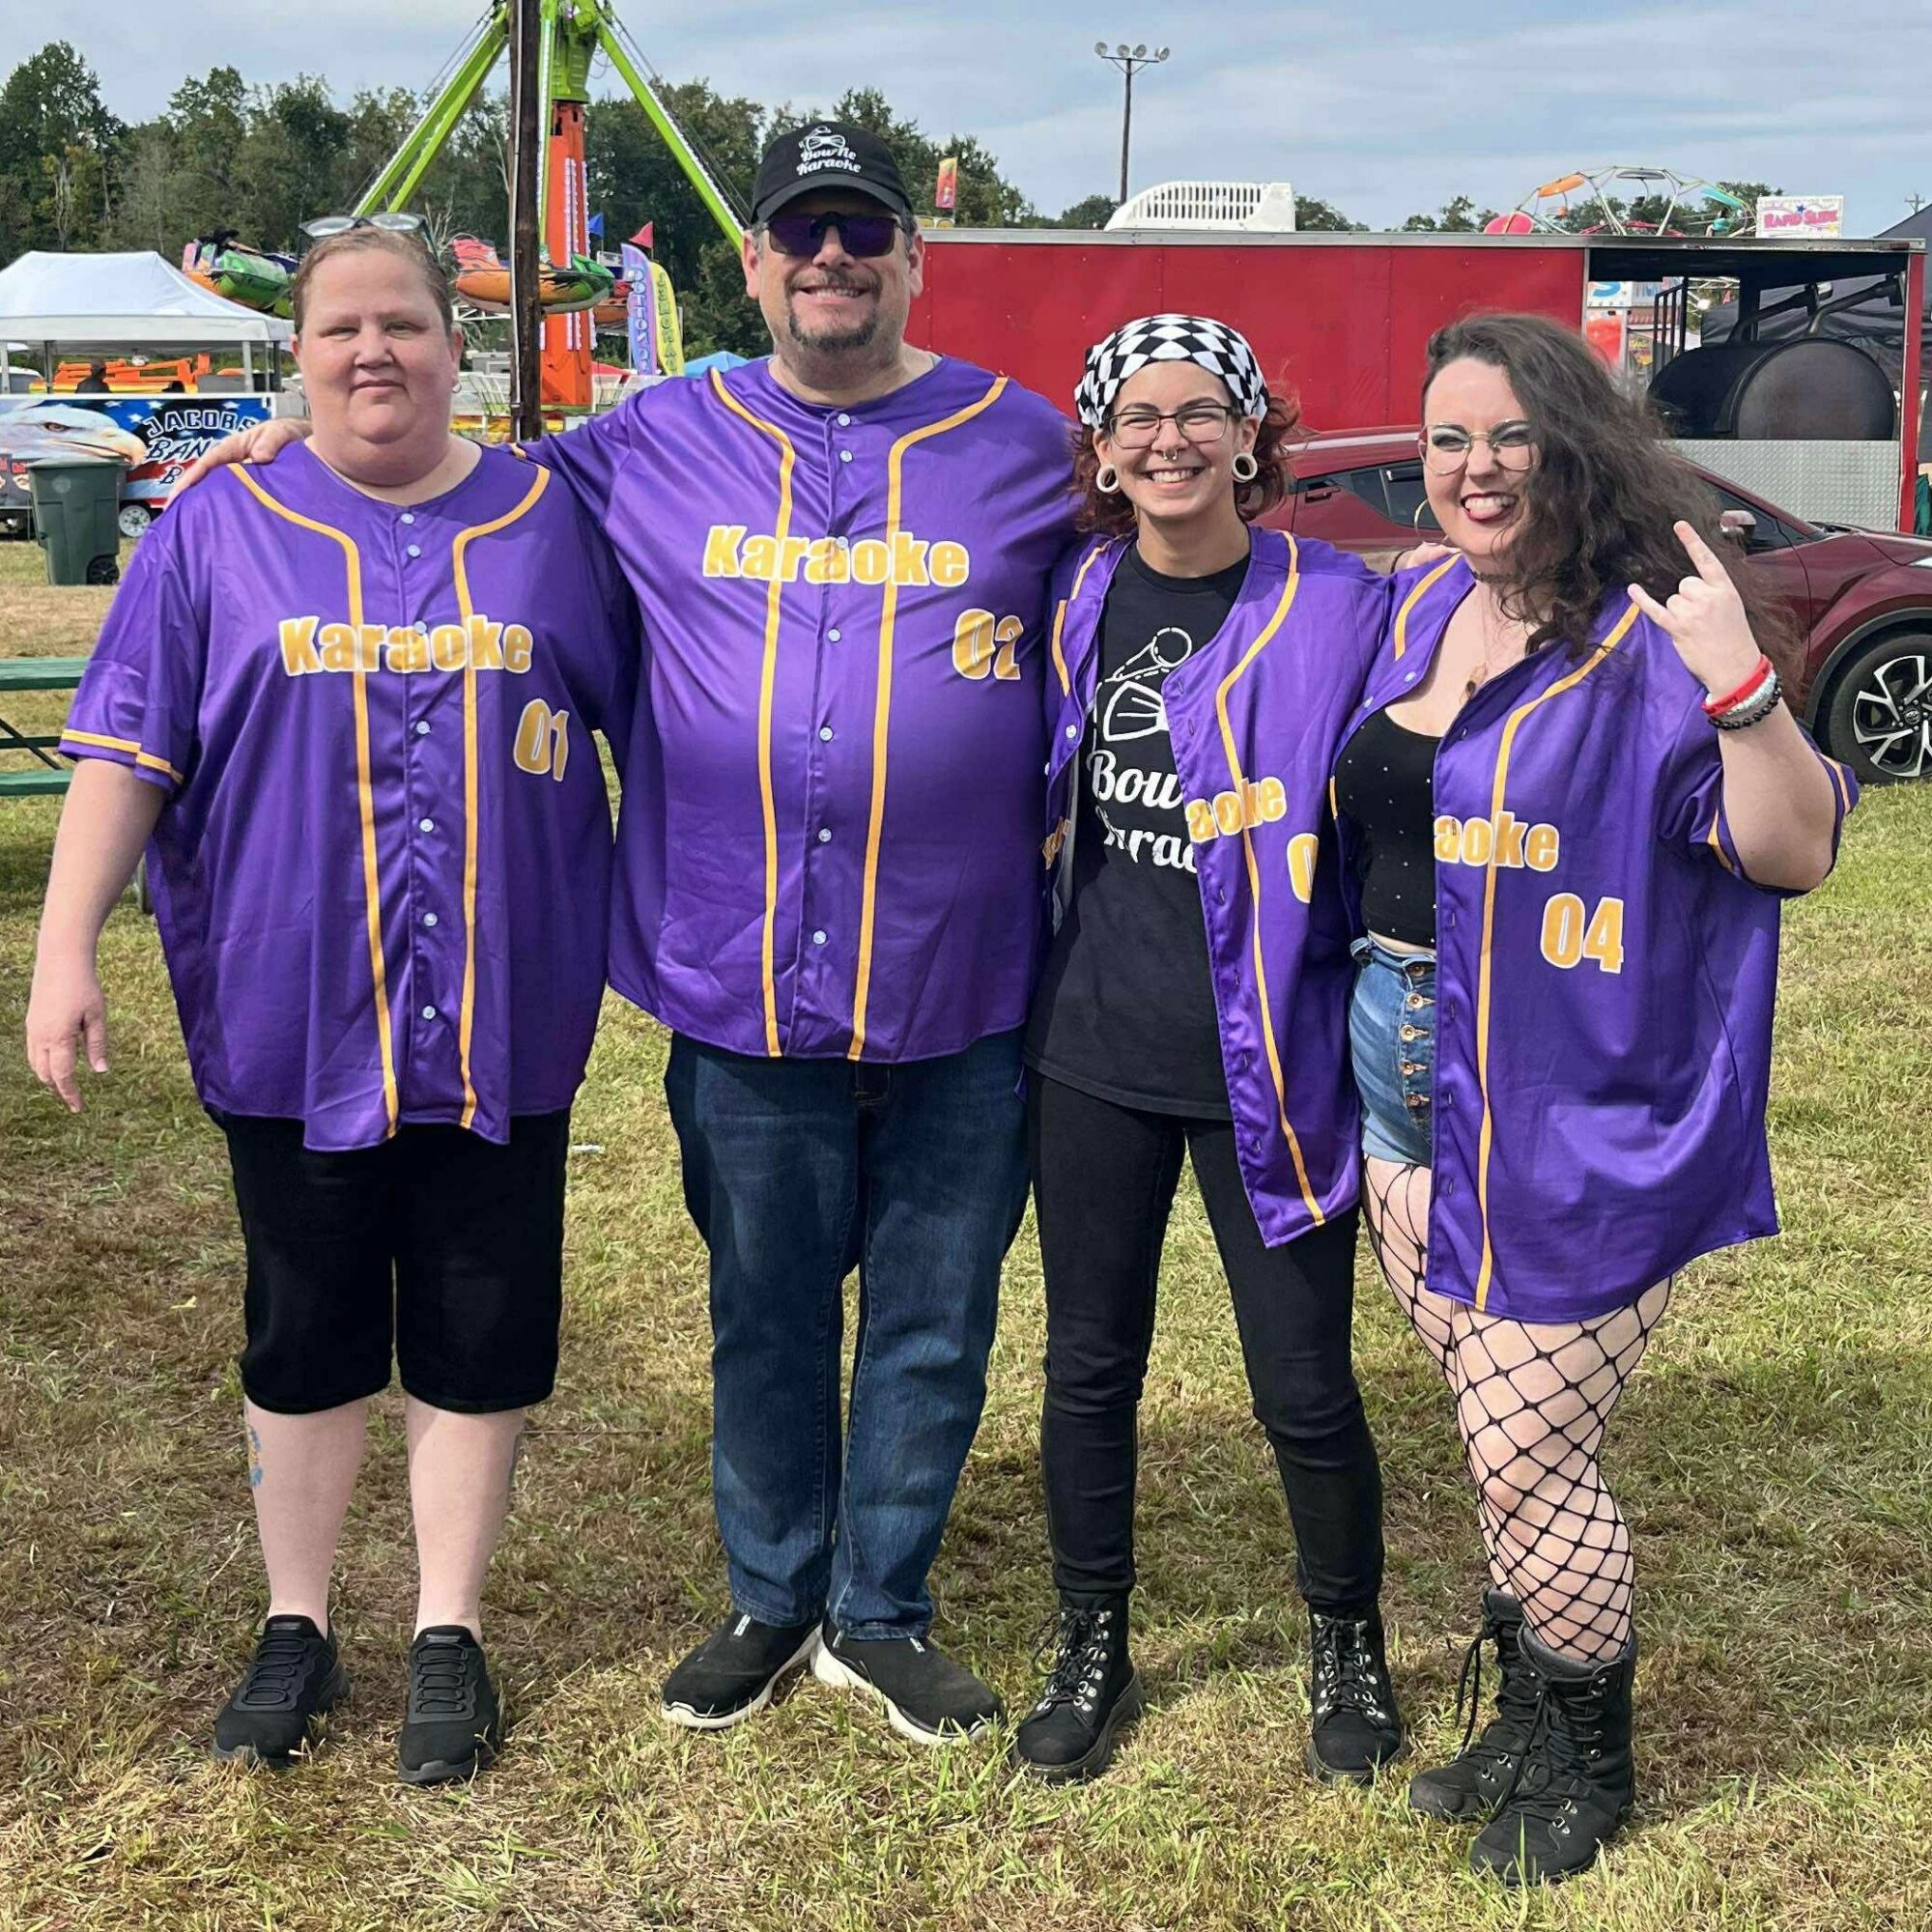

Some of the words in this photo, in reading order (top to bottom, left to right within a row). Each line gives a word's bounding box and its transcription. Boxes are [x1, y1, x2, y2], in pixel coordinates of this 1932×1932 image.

[796, 158, 862, 176] Karaoke
[702, 525, 970, 588] Karaoke
[278, 614, 533, 676] Karaoke
[952, 608, 1024, 680] 02
[513, 697, 570, 782] 01
[1540, 892, 1625, 975] 04
